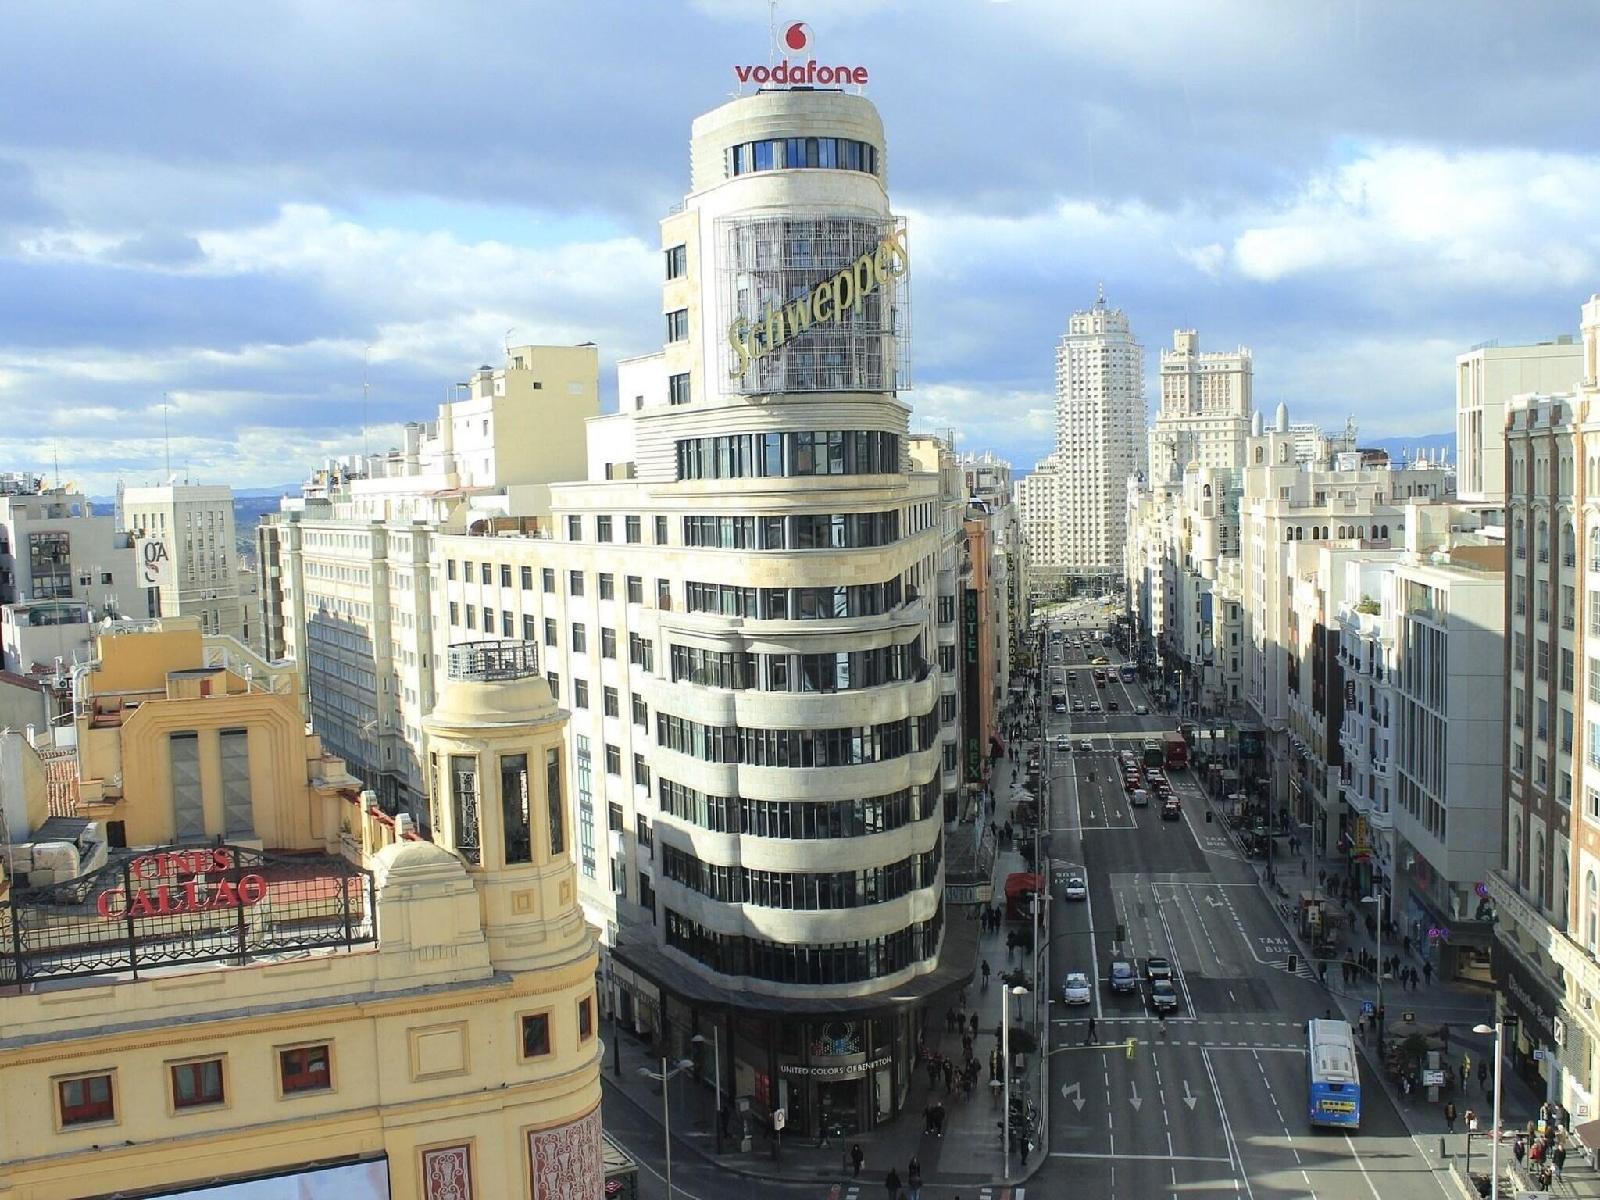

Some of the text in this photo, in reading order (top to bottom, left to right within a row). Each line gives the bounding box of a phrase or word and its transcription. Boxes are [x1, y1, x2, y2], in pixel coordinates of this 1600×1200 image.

[735, 60, 868, 84] vodafone
[729, 228, 907, 379] Schweppes
[967, 594, 980, 778] HOTEL REX
[129, 847, 232, 879] CINES
[97, 874, 268, 917] CALLAO
[780, 1055, 892, 1075] UNITED COLORS OF BENETTON
